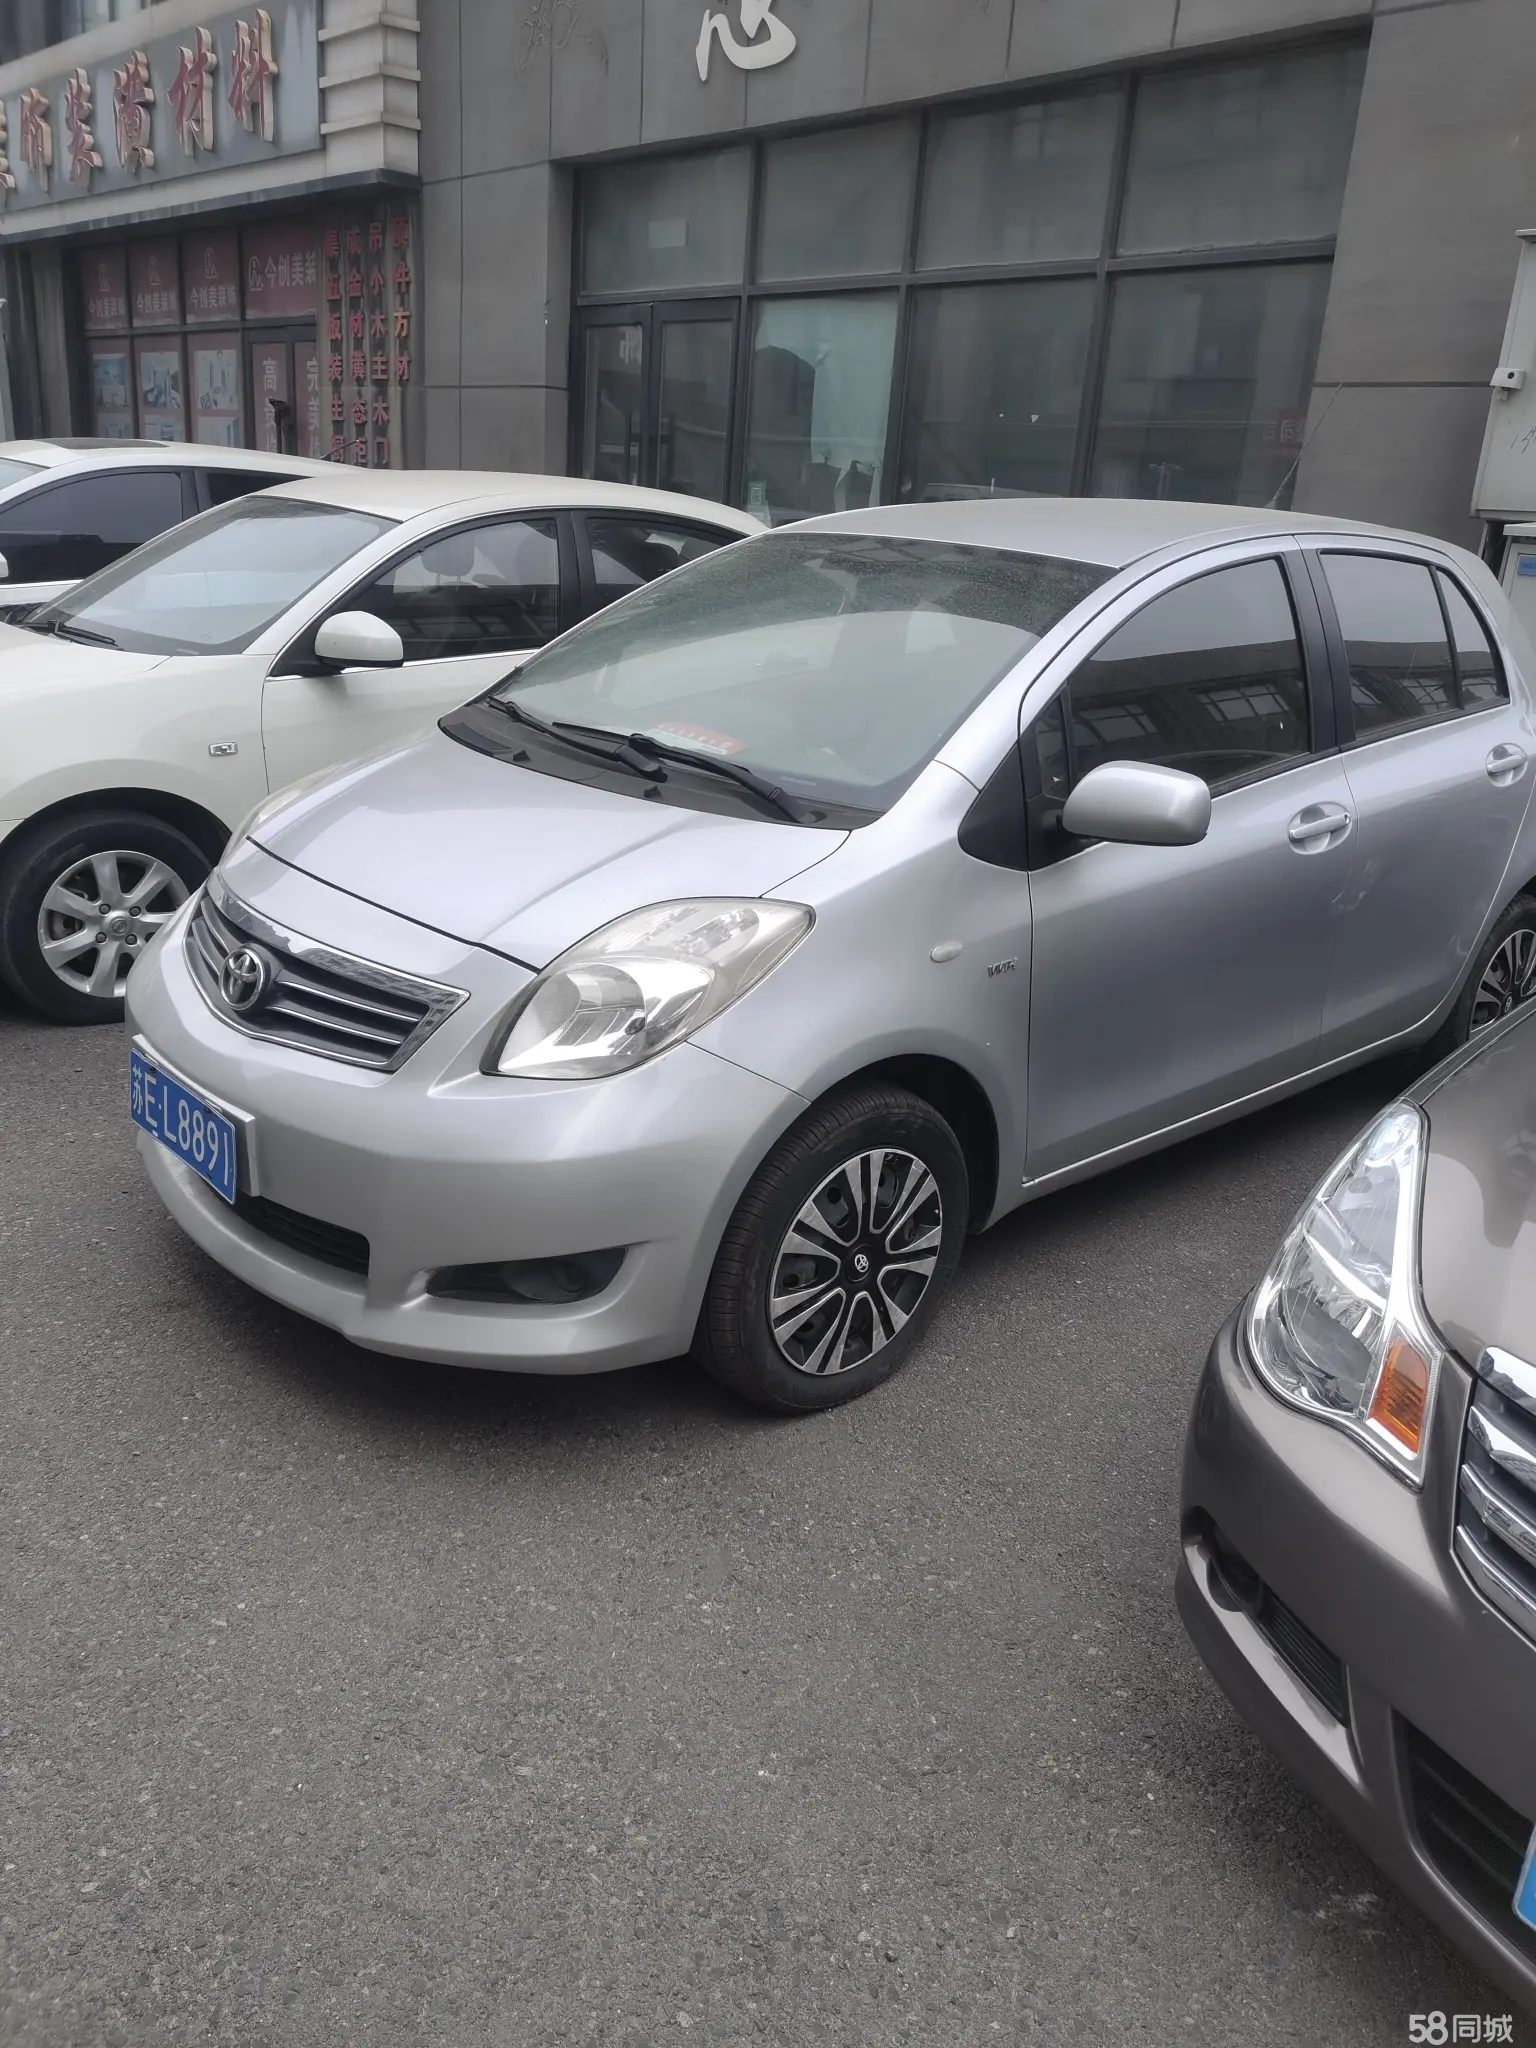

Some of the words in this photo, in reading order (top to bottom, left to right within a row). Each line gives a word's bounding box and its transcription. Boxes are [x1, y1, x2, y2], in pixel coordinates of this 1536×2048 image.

[0, 9, 279, 205] 饰装潢材料
